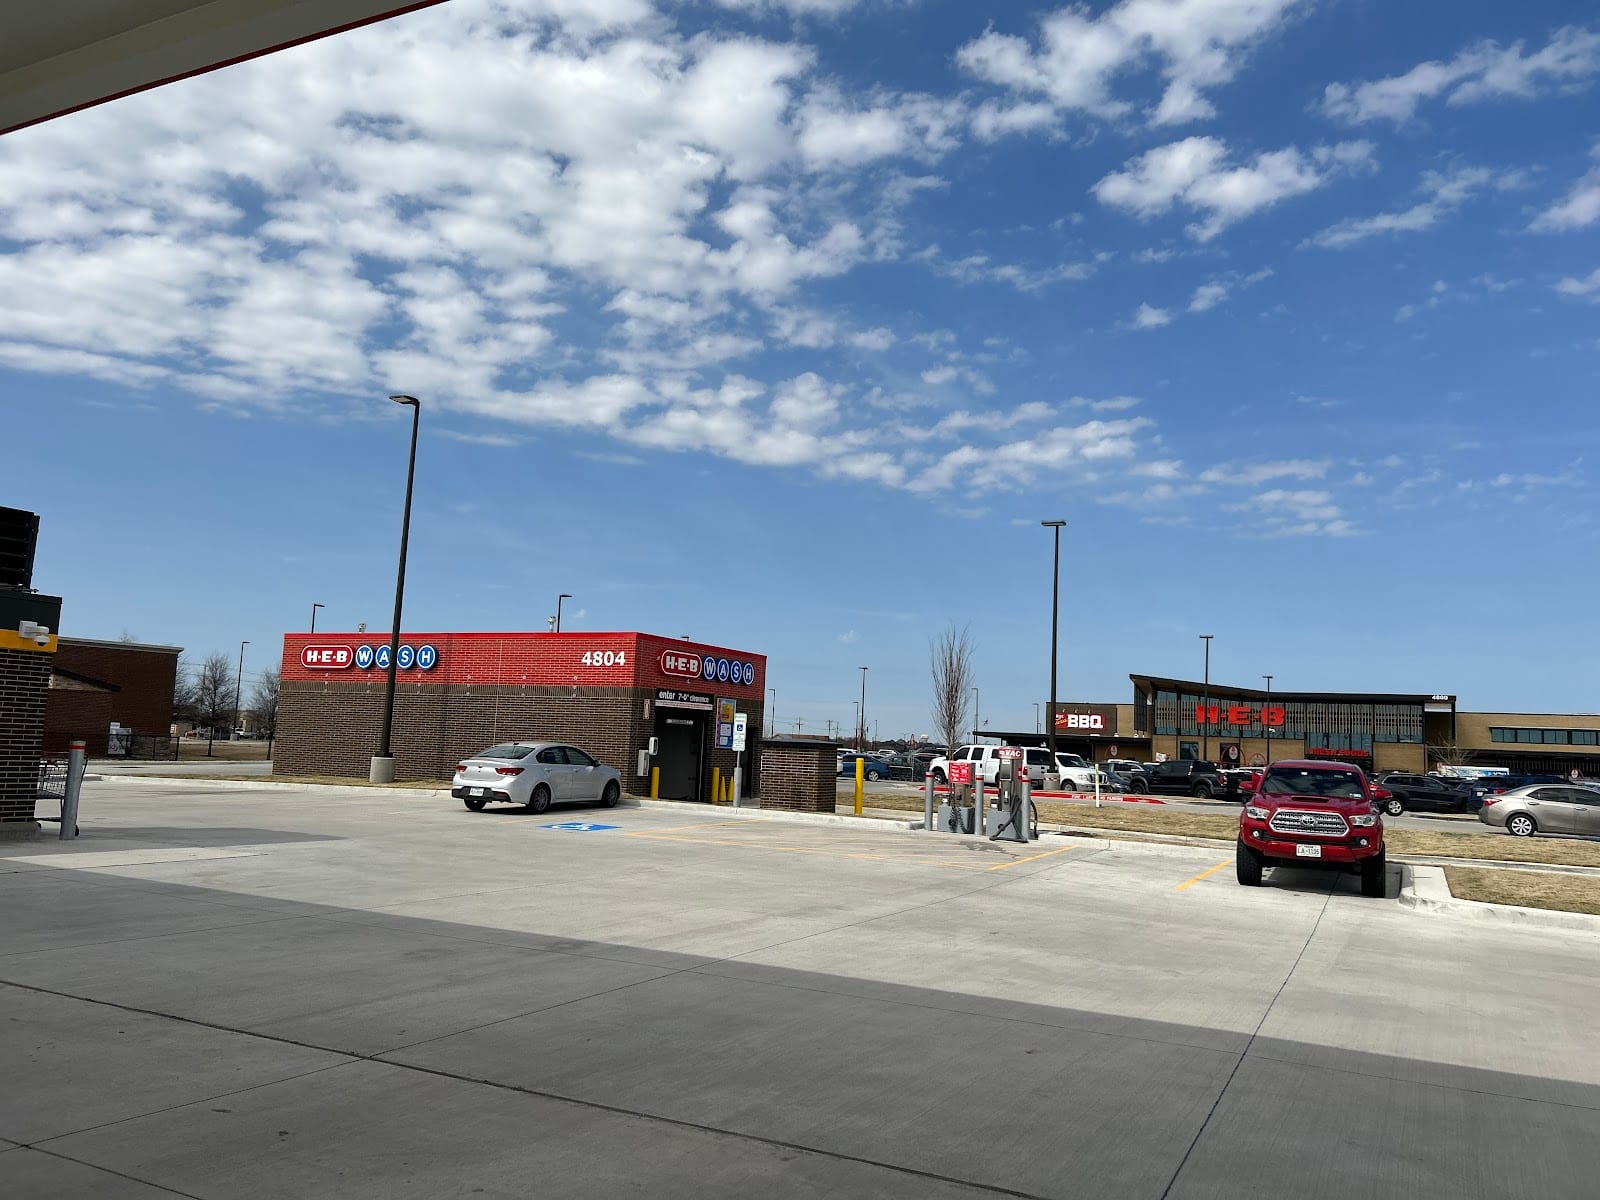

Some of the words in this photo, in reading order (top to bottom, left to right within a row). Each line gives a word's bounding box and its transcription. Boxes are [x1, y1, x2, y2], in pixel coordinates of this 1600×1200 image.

[358, 650, 431, 663] WASH
[581, 651, 626, 667] 4804
[705, 660, 752, 680] WASH
[659, 690, 676, 700] enter
[1067, 714, 1104, 729] BBQ
[1005, 749, 1021, 758] VAC
